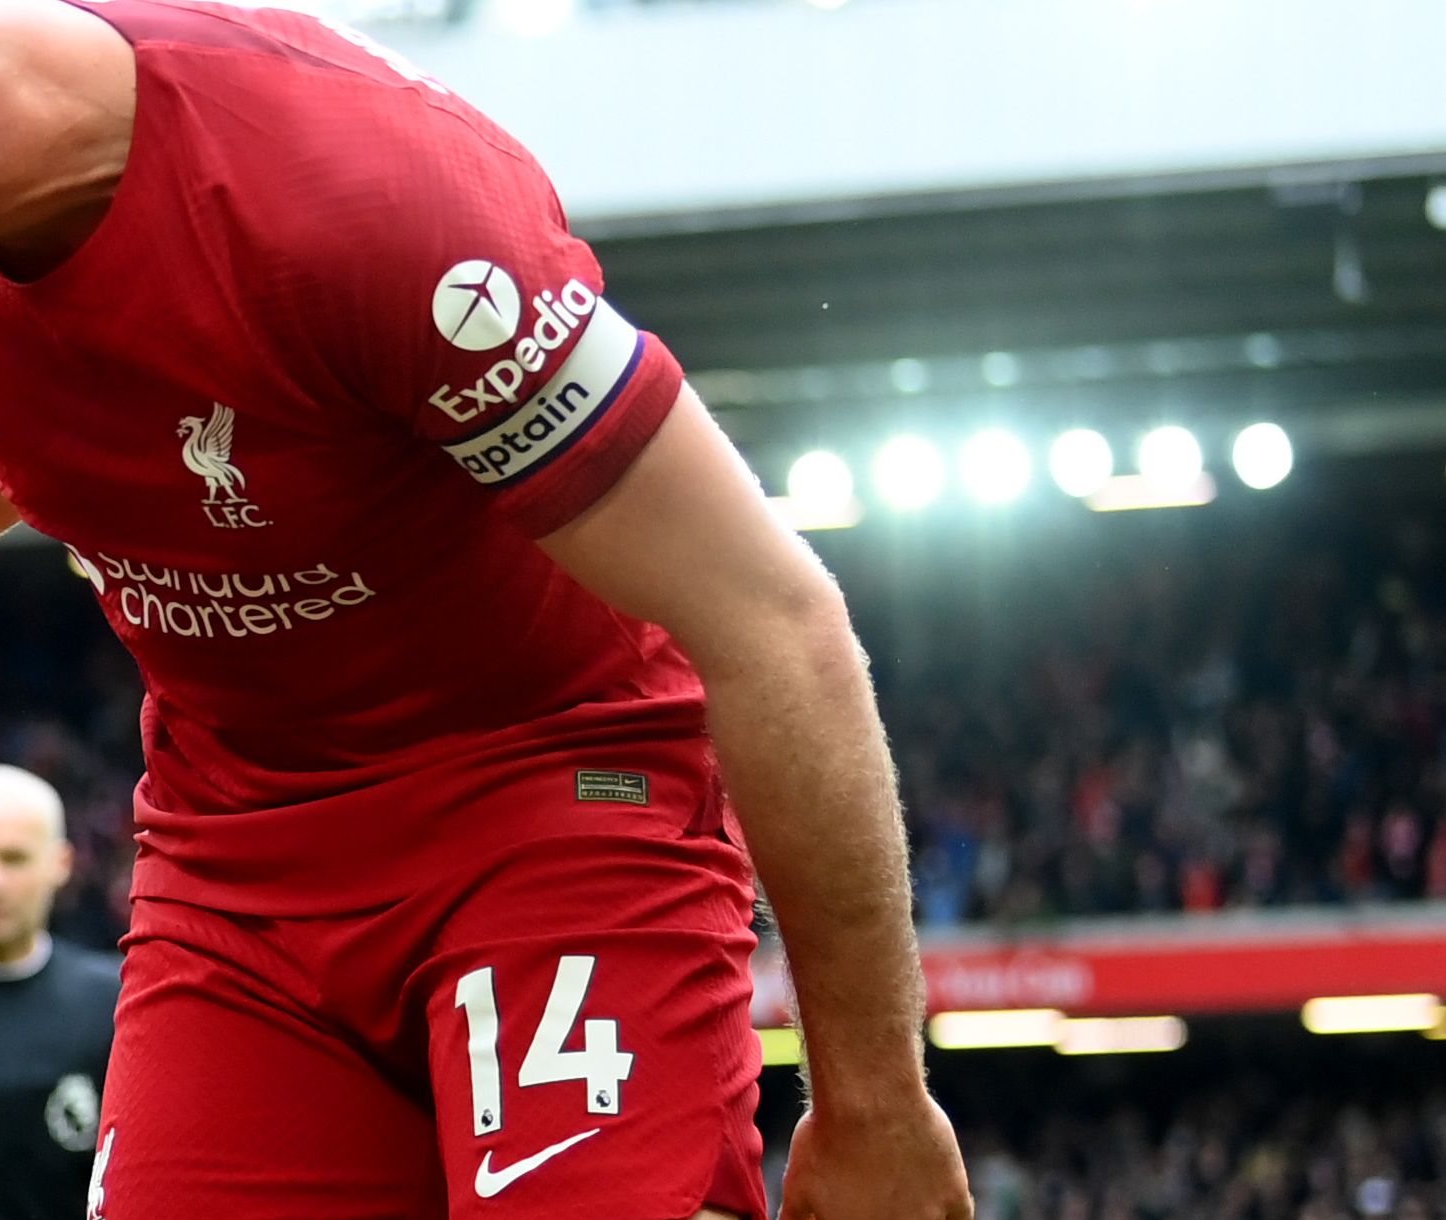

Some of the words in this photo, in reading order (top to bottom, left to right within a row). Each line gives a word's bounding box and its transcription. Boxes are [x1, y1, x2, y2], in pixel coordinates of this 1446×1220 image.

[428, 278, 597, 423] Expedia
[462, 381, 590, 476] aptain
[203, 505, 274, 529] L.F.C.
[121, 572, 377, 638] chartered
[455, 956, 635, 1137] 14
